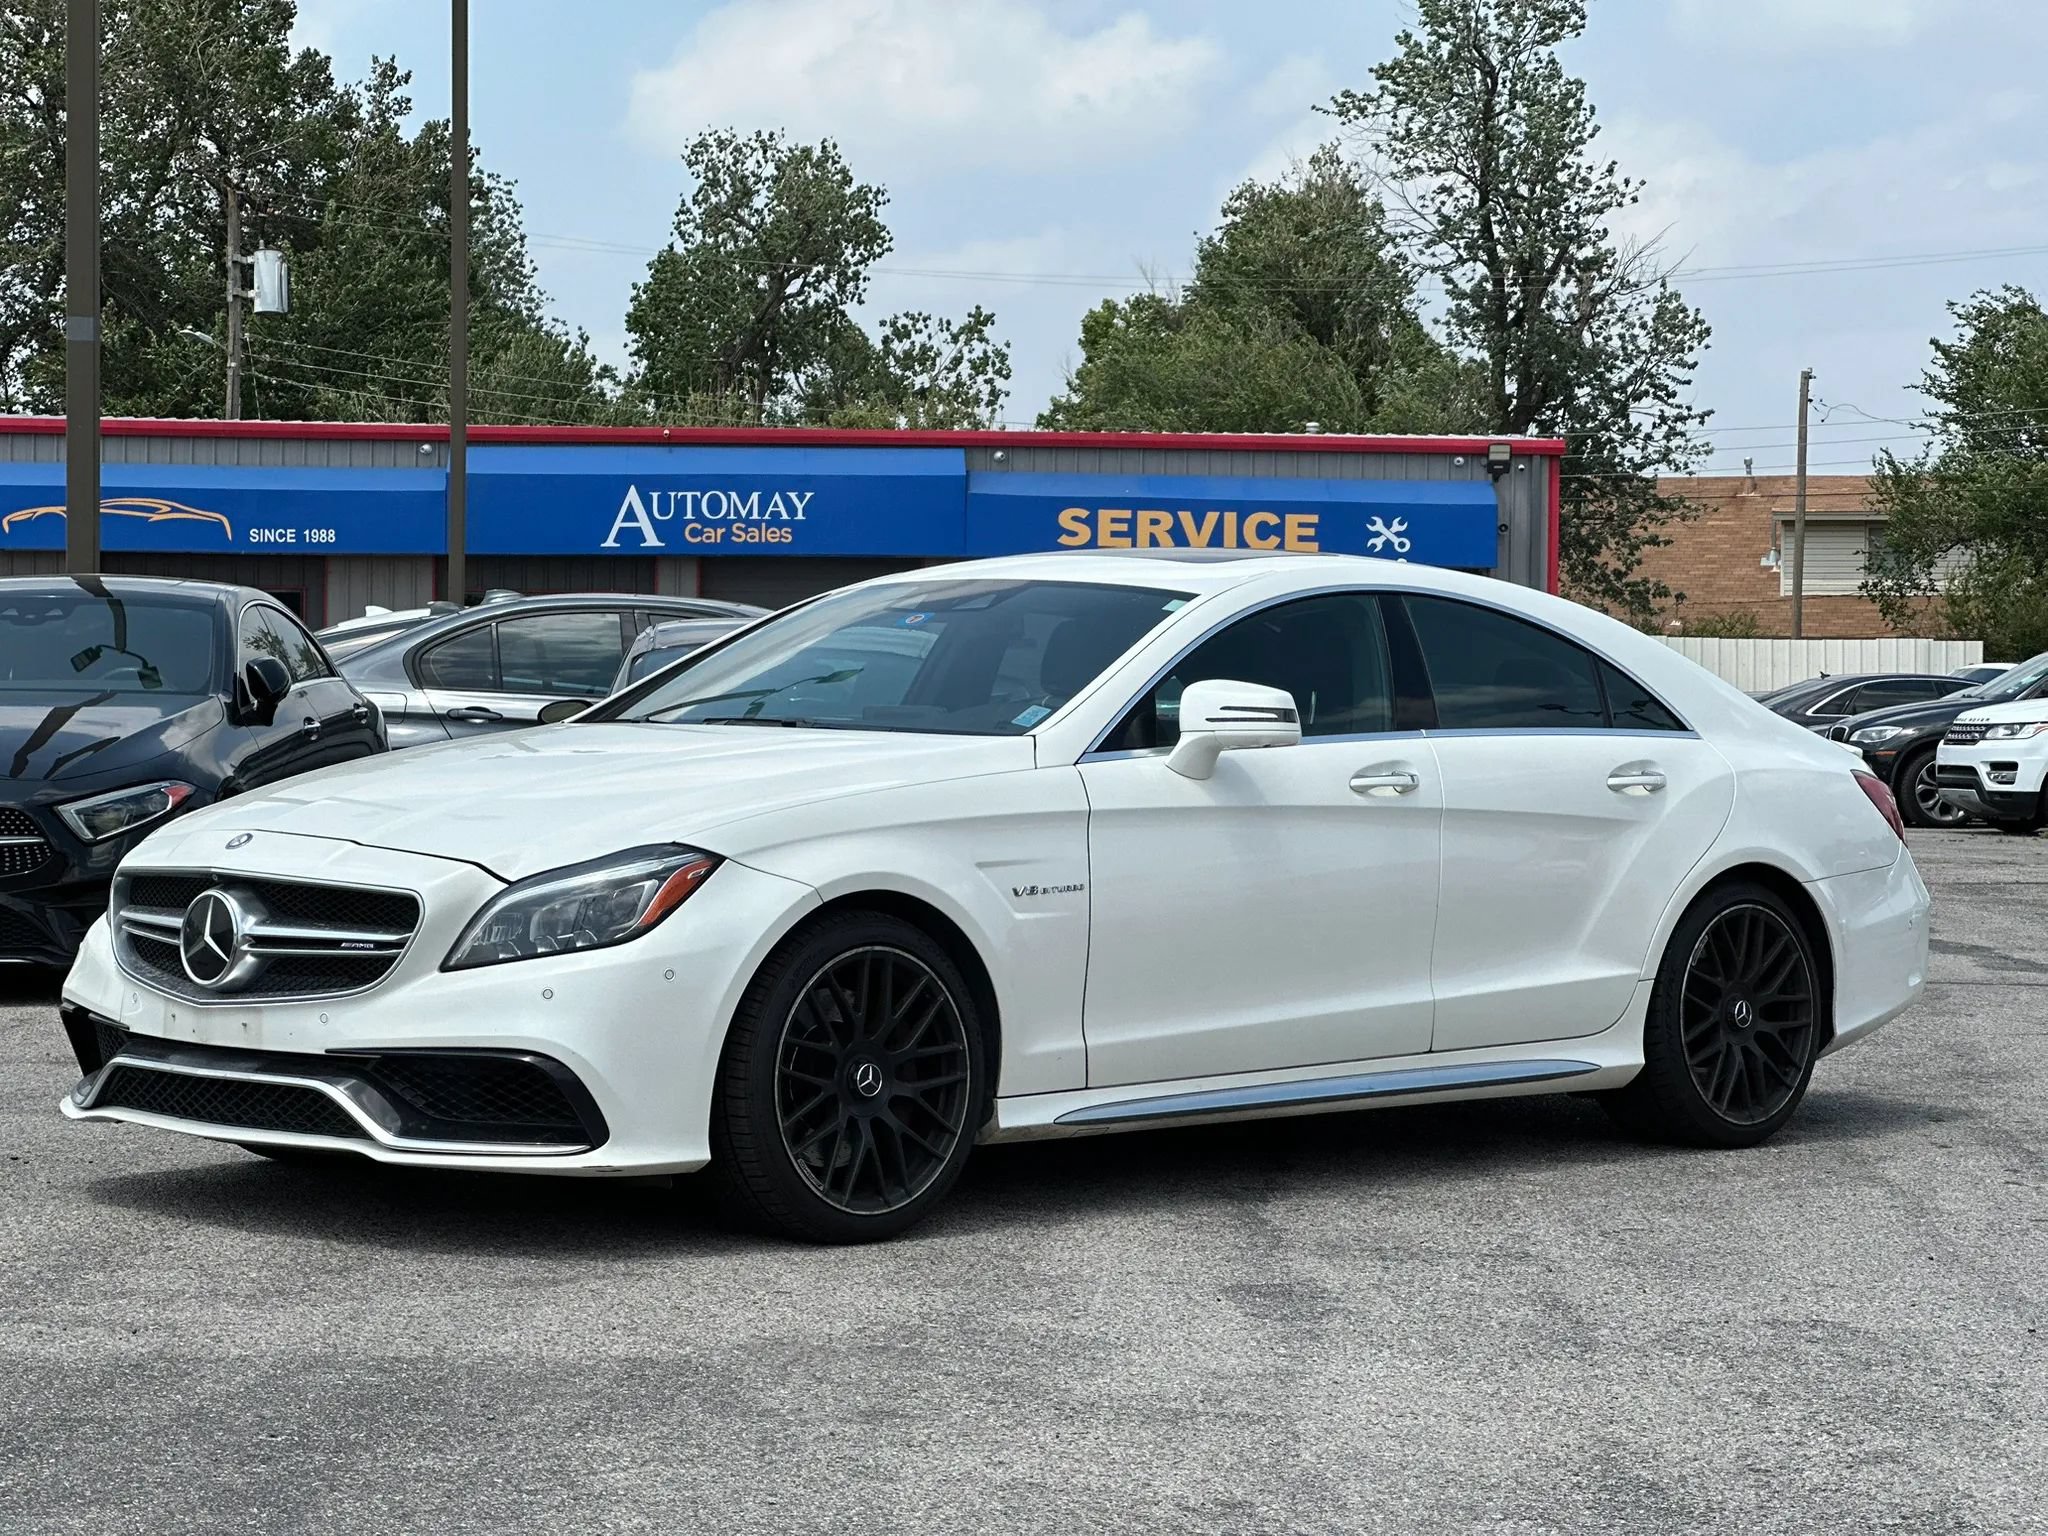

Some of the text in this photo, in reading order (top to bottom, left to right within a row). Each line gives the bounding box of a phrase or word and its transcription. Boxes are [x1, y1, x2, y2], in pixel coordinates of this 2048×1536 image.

[600, 484, 815, 547] AUTOMAY
[1057, 507, 1319, 552] SERVICE
[249, 528, 336, 543] SINCE 1988
[684, 522, 793, 543] Car Sales
